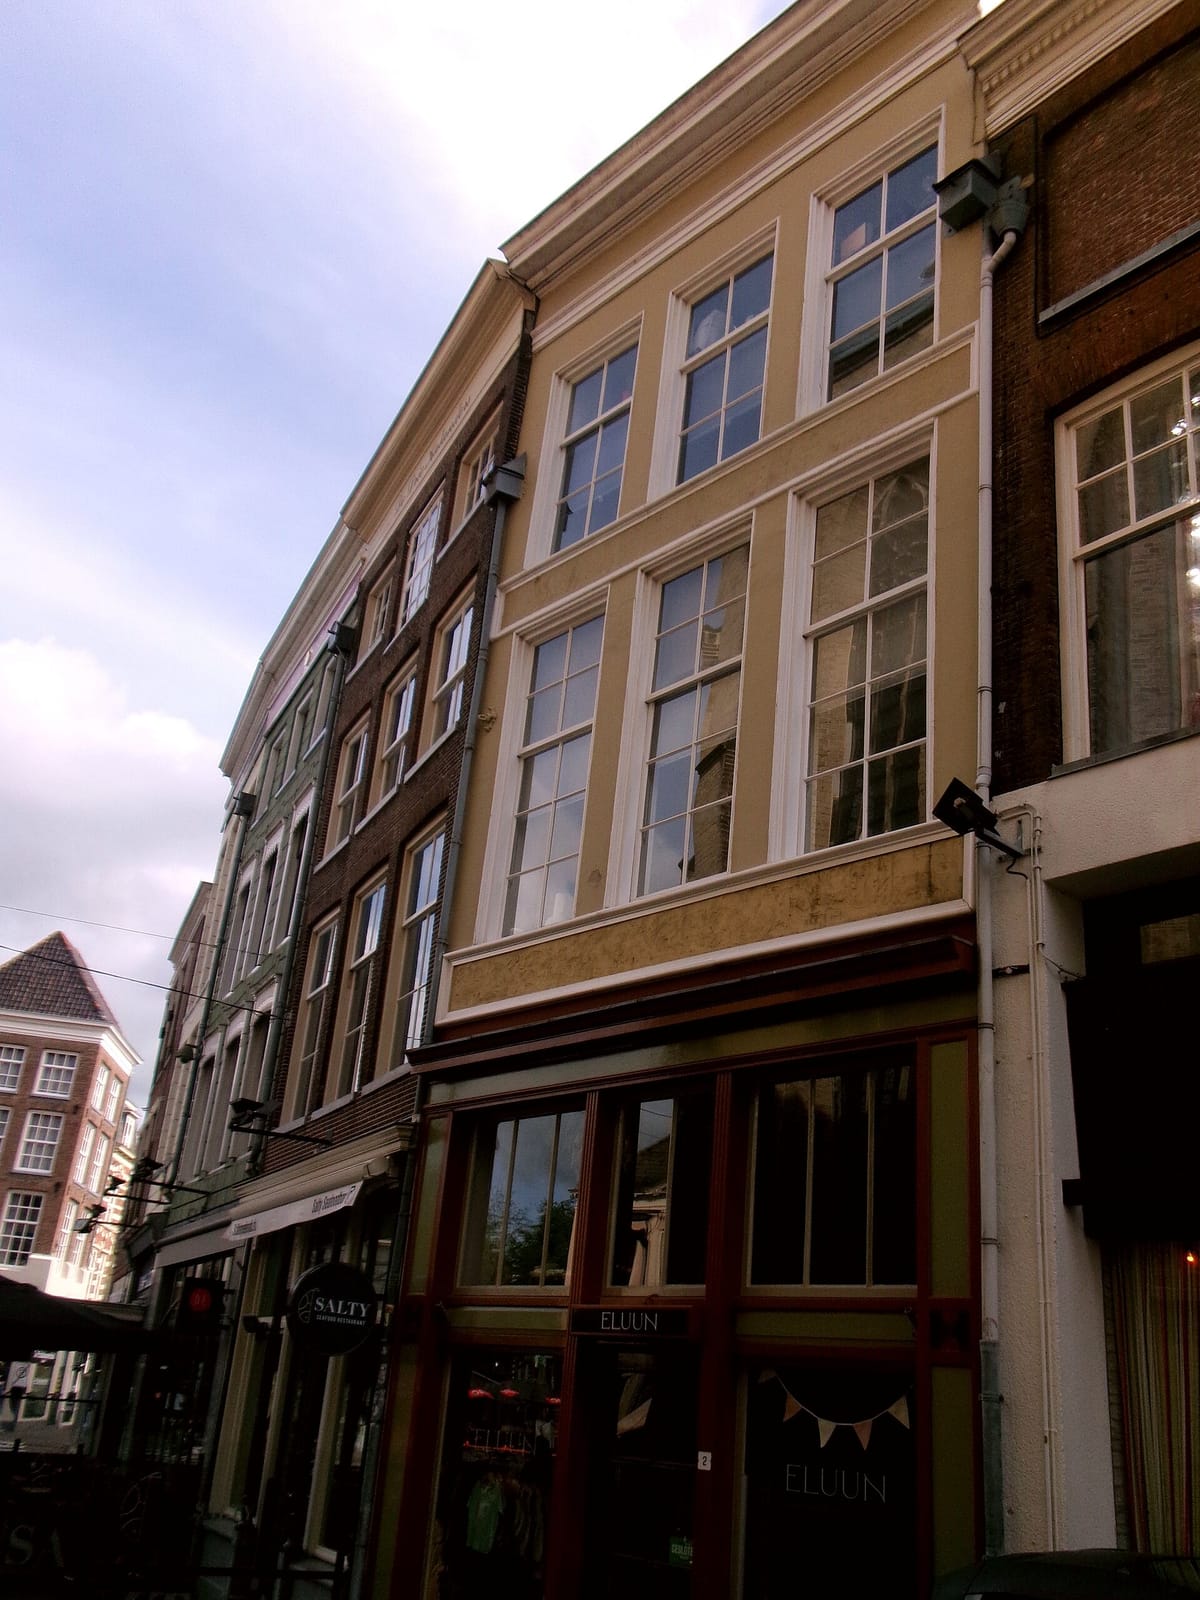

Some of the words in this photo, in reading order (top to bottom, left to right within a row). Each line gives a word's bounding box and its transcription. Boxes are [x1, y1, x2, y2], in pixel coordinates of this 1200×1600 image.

[314, 1296, 371, 1318] SALTY
[600, 1311, 659, 1331] ELUUN
[785, 1463, 887, 1504] ELUUN
